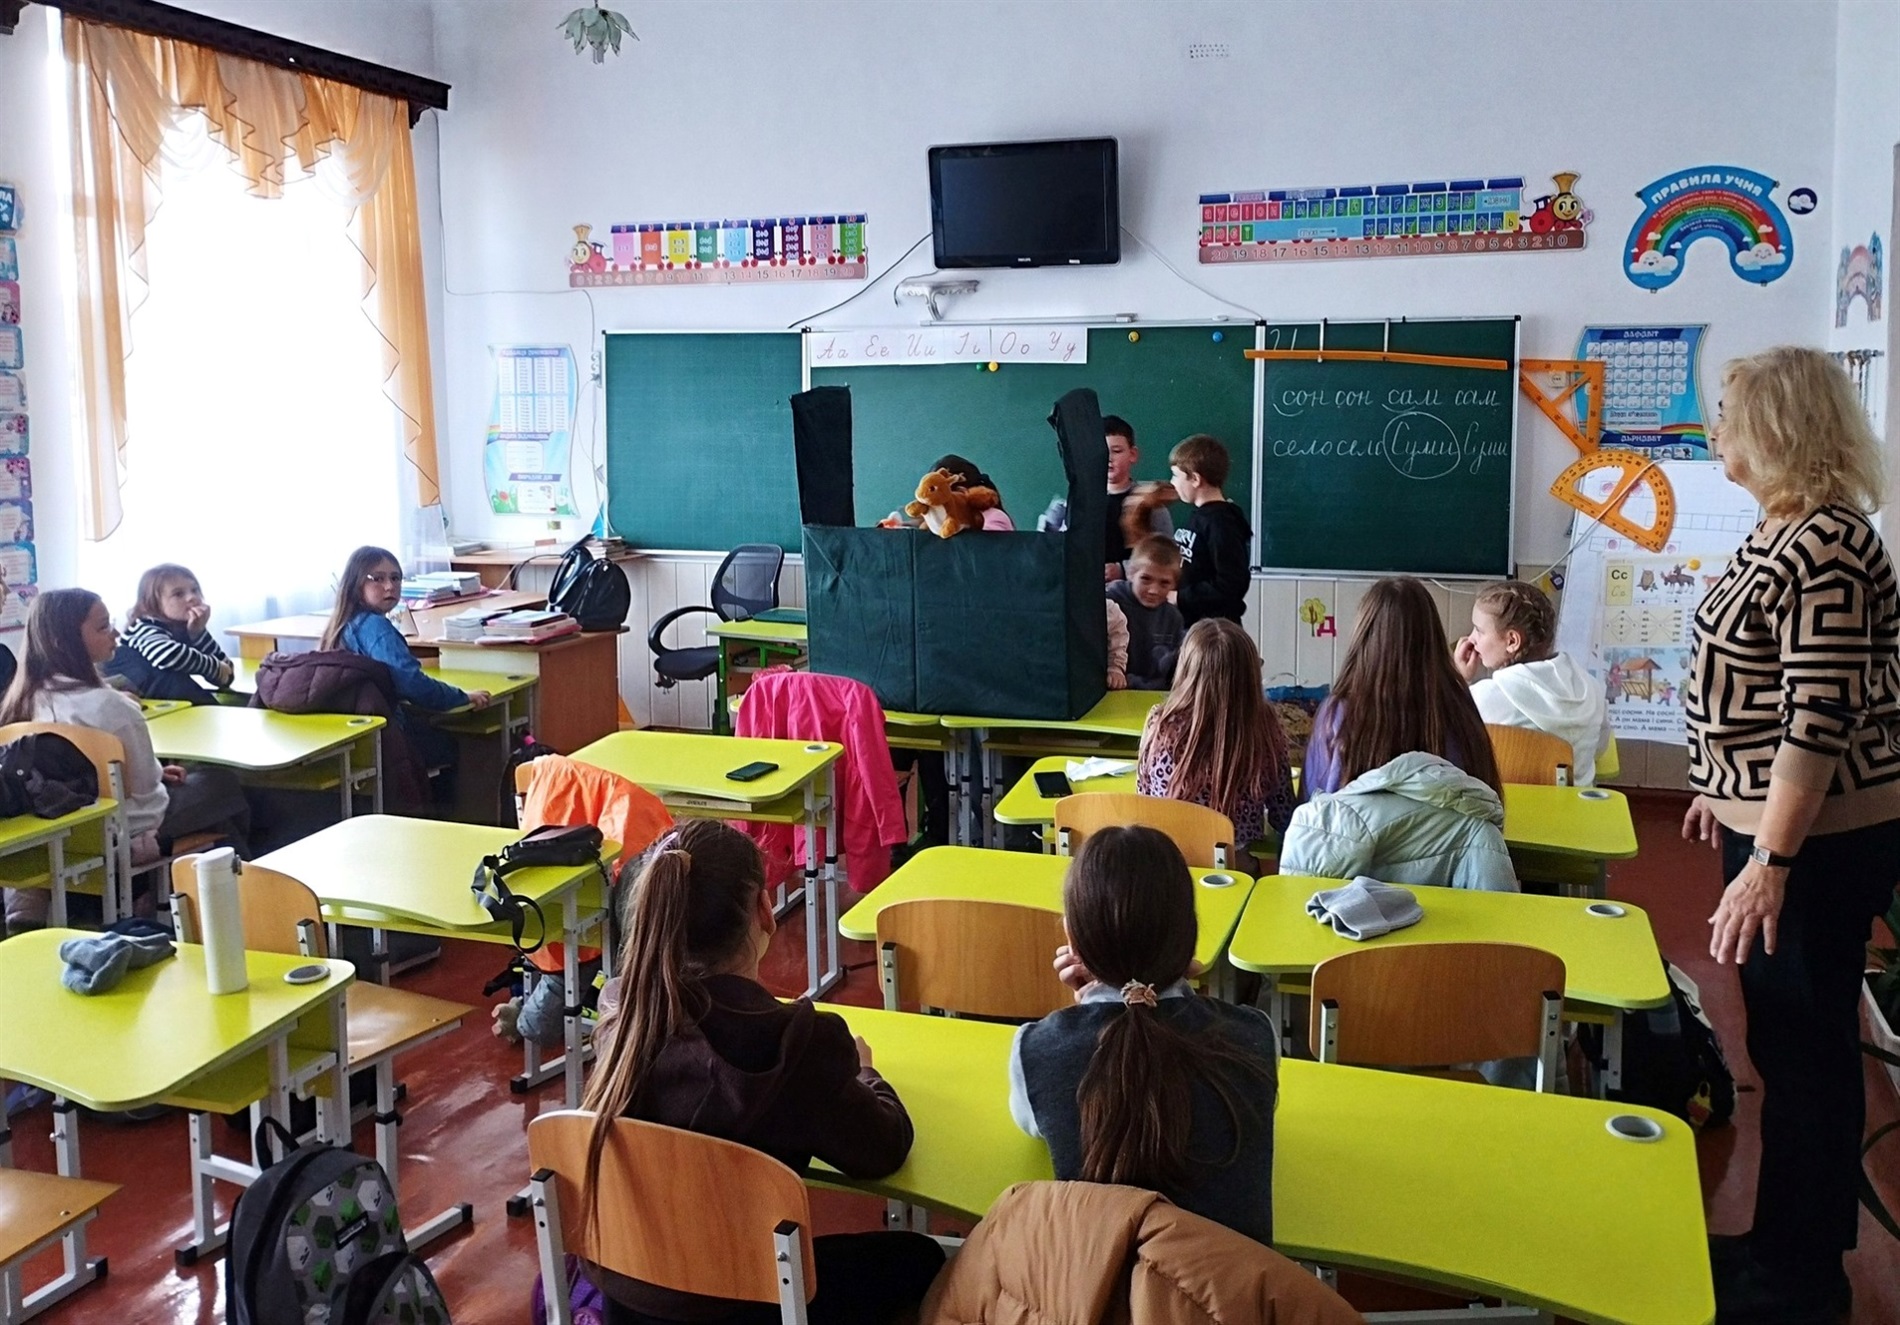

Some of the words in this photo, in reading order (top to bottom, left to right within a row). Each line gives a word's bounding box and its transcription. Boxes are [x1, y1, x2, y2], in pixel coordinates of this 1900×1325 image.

[1651, 174, 1721, 204] ПРАВИЛА
[1724, 174, 1763, 197] УЧНЯ
[1211, 249, 1228, 261] 20
[1233, 249, 1248, 259] 19
[1253, 248, 1267, 259] 18
[1273, 247, 1287, 258] 17
[1293, 247, 1307, 257] 16
[1314, 246, 1328, 256] 15
[1334, 244, 1349, 256] 14
[1355, 243, 1370, 254] 13
[1375, 242, 1391, 253] 12
[1396, 242, 1409, 253] 11
[1414, 241, 1431, 252] 10
[1434, 240, 1444, 251] 9
[1447, 239, 1458, 251] 8
[1461, 239, 1471, 250] 7
[1475, 238, 1486, 249] 6
[1489, 237, 1499, 249] 5
[1503, 237, 1514, 249] 4
[1518, 236, 1528, 248] 3
[1532, 235, 1543, 248] 2
[1546, 235, 1554, 247] 1
[1557, 234, 1568, 247] 0
[666, 272, 674, 281] 9
[693, 271, 704, 281] 11
[724, 271, 736, 280] 13
[757, 269, 769, 279] 15
[774, 269, 786, 278] 16
[790, 269, 802, 278] 17
[807, 268, 819, 277] 18
[824, 267, 836, 277] 19
[816, 337, 849, 359] Аа
[865, 334, 890, 358] Ее
[1000, 331, 1030, 355] Оо
[1049, 331, 1076, 361] Уу
[1282, 389, 1330, 406] сон
[1335, 389, 1373, 407] сон
[1388, 388, 1442, 406] сам
[1455, 388, 1500, 406] сам
[1273, 439, 1334, 457] село
[1391, 420, 1459, 473] Суми
[1611, 569, 1628, 580] Сс
[1317, 615, 1336, 637] Д
